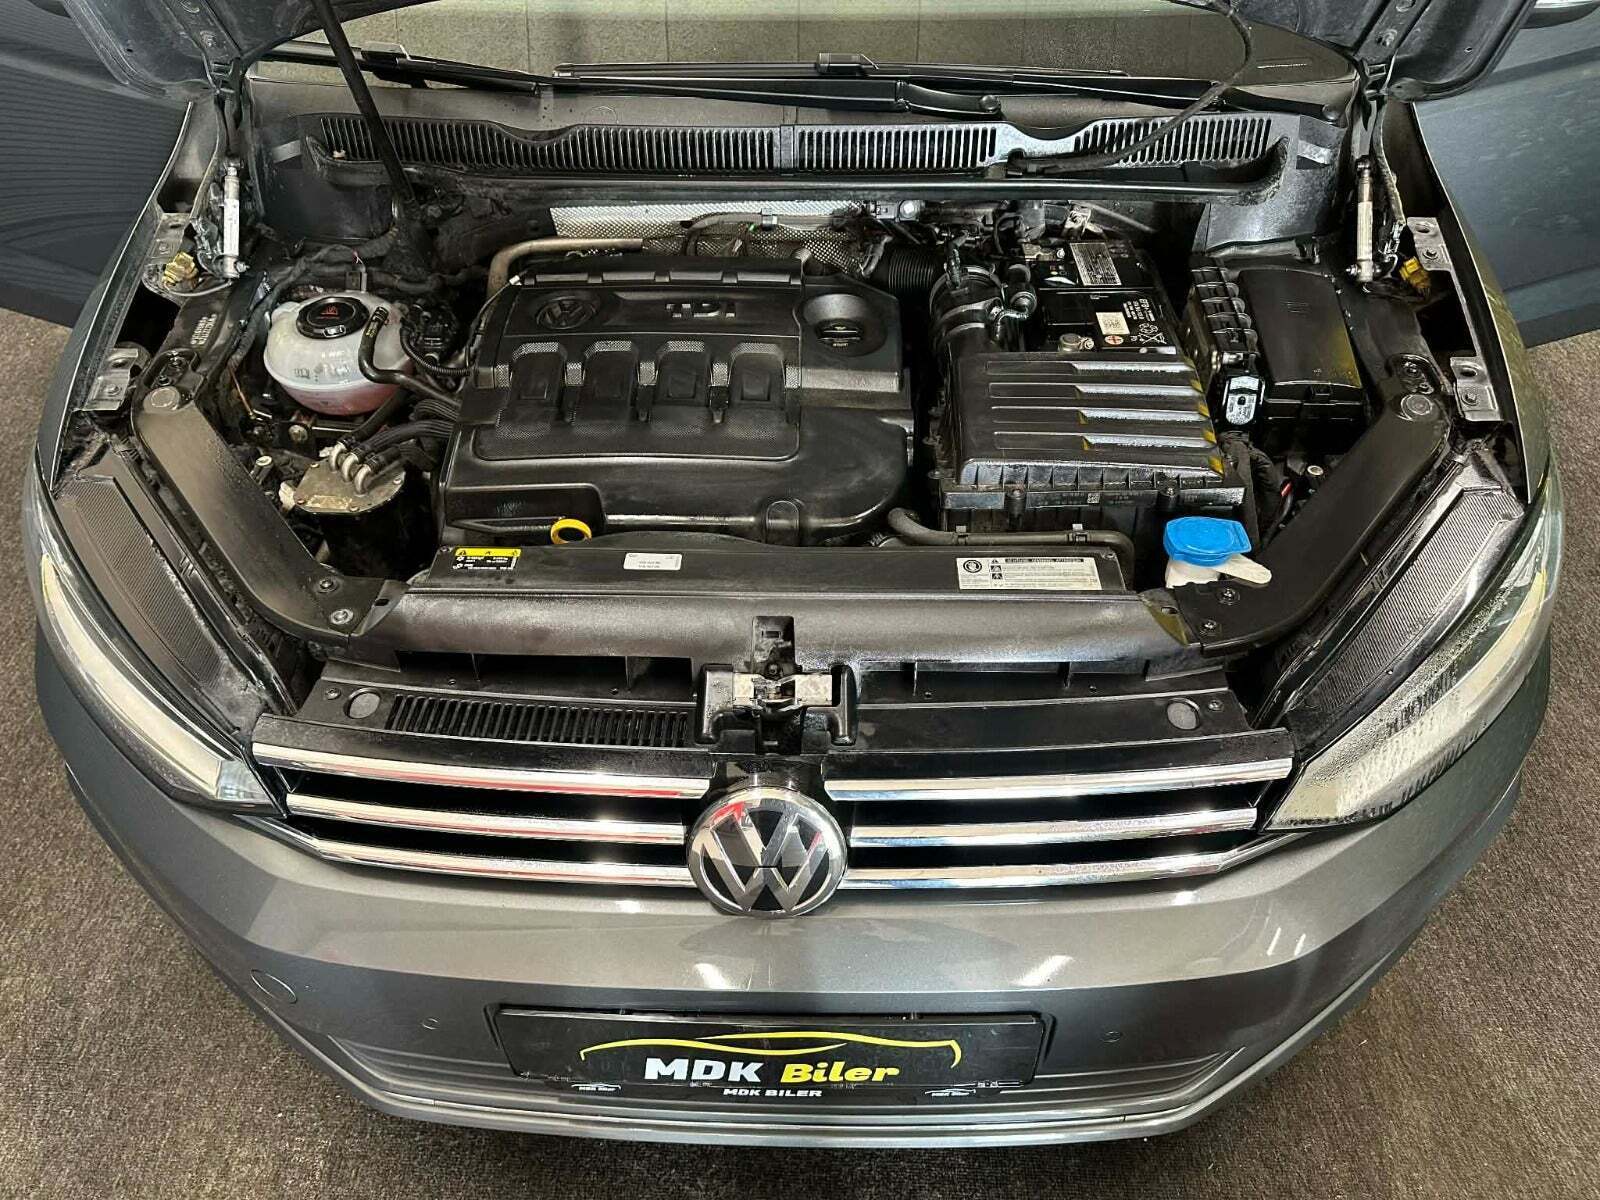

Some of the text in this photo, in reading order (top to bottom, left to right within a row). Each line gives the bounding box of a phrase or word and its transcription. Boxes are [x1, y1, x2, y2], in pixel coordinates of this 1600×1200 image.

[666, 303, 736, 318] TDI
[644, 1057, 900, 1083] MDK Biler
[723, 1088, 823, 1097] MDK BILER
